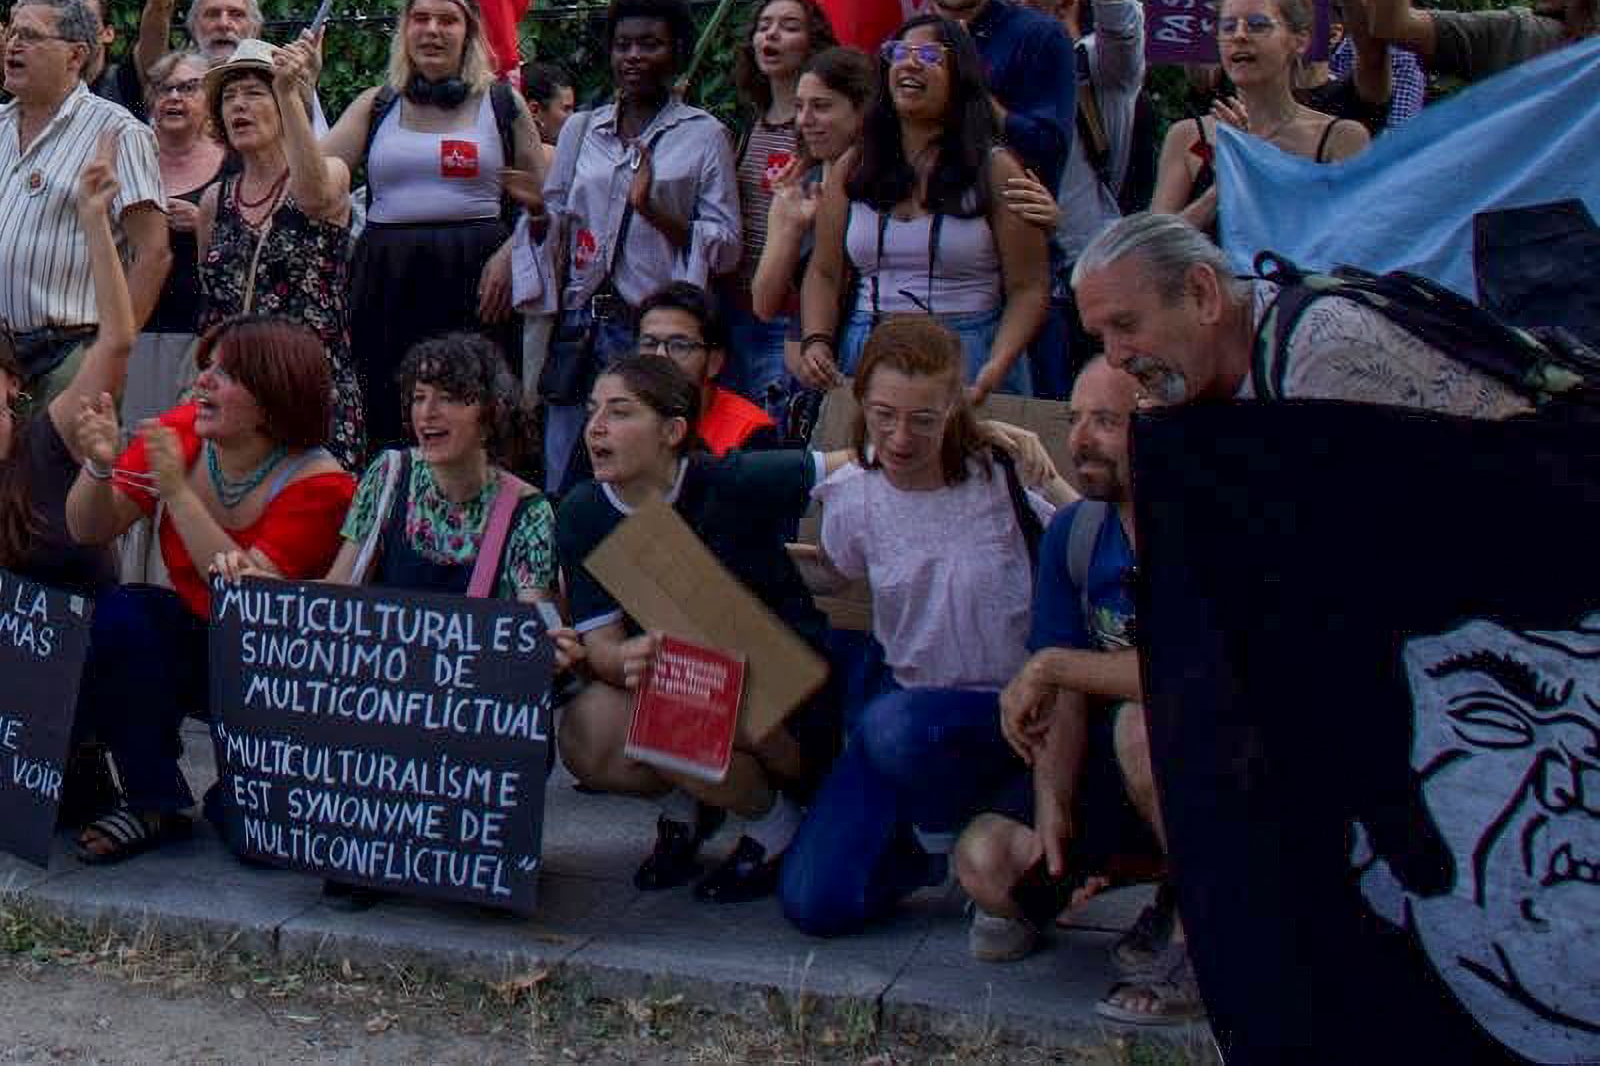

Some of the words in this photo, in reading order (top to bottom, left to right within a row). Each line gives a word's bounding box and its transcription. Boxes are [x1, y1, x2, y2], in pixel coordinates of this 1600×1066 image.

[15, 584, 48, 622] LA
[492, 617, 537, 653] ES
[435, 654, 475, 689] DE
[234, 775, 272, 814] EST
[288, 788, 448, 839] SYNONYME
[460, 809, 505, 847] DE
